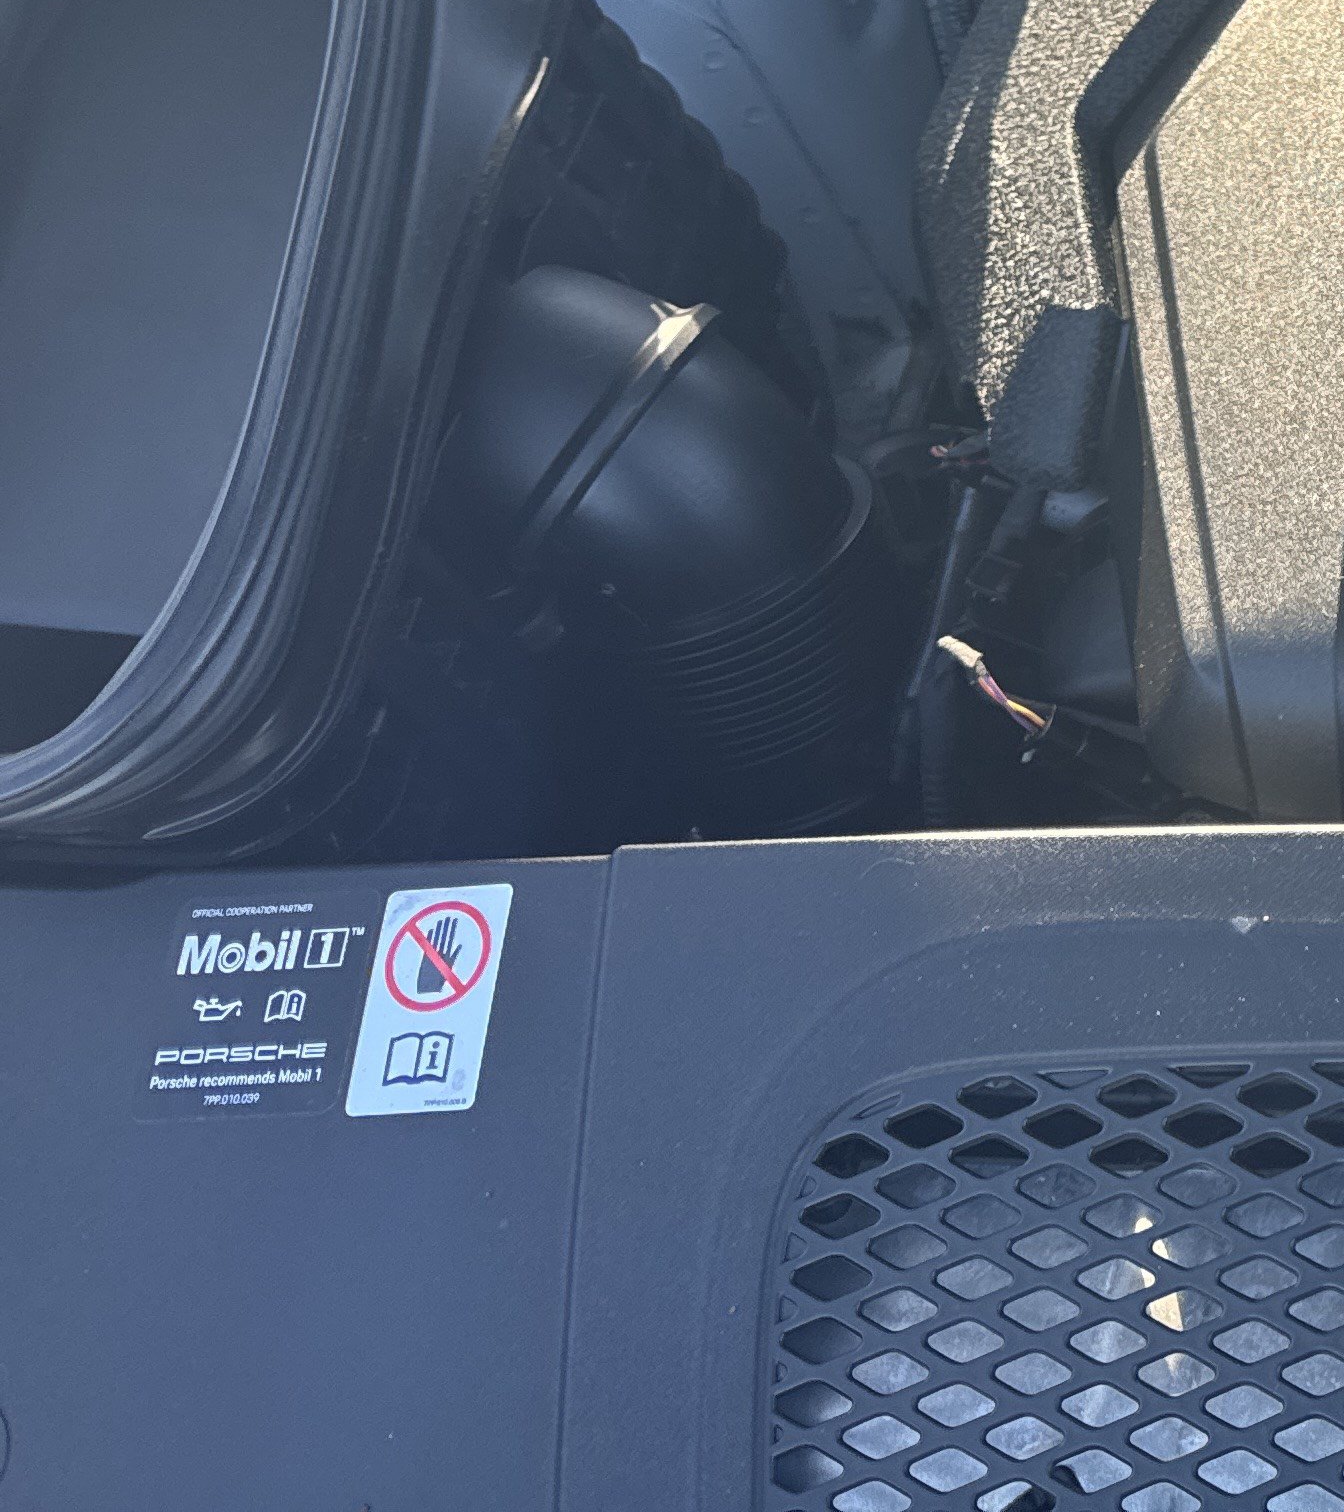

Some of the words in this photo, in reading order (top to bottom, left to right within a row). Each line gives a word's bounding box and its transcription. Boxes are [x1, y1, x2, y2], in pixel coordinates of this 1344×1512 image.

[176, 929, 302, 976] Mobil
[154, 1042, 328, 1066] PORSCHE
[150, 1073, 197, 1090] Porsche
[199, 1071, 276, 1087] recommends
[278, 1068, 312, 1083] Mobil
[314, 1067, 322, 1082] 1
